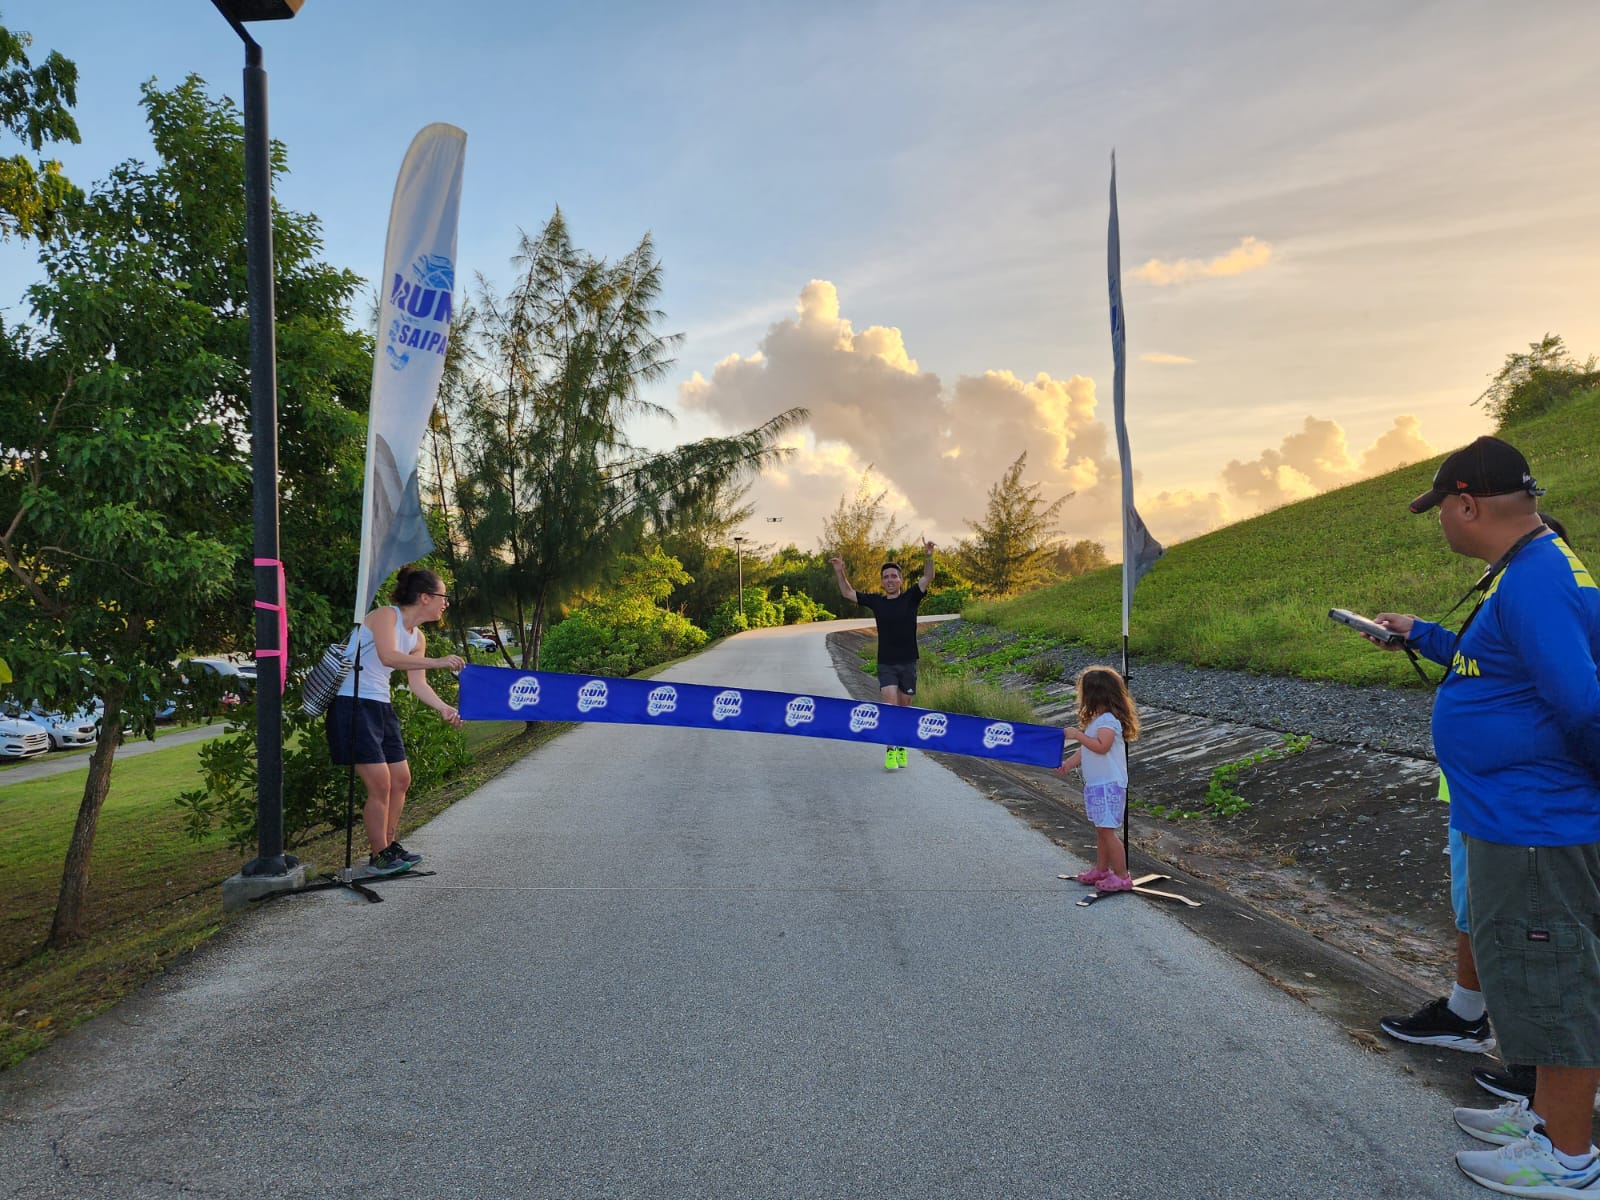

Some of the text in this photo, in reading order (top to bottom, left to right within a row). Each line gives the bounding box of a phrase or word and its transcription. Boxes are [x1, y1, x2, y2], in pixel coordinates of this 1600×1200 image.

[399, 324, 447, 356] SAIPA
[1452, 649, 1481, 676] PAN
[512, 686, 538, 694] RUN
[580, 689, 606, 697] RUN
[651, 692, 675, 701] RUN
[716, 697, 740, 706] RUN
[789, 703, 813, 712] RUN
[853, 709, 878, 718] RUN
[921, 717, 946, 726] RUN
[987, 728, 1012, 736] RUN
